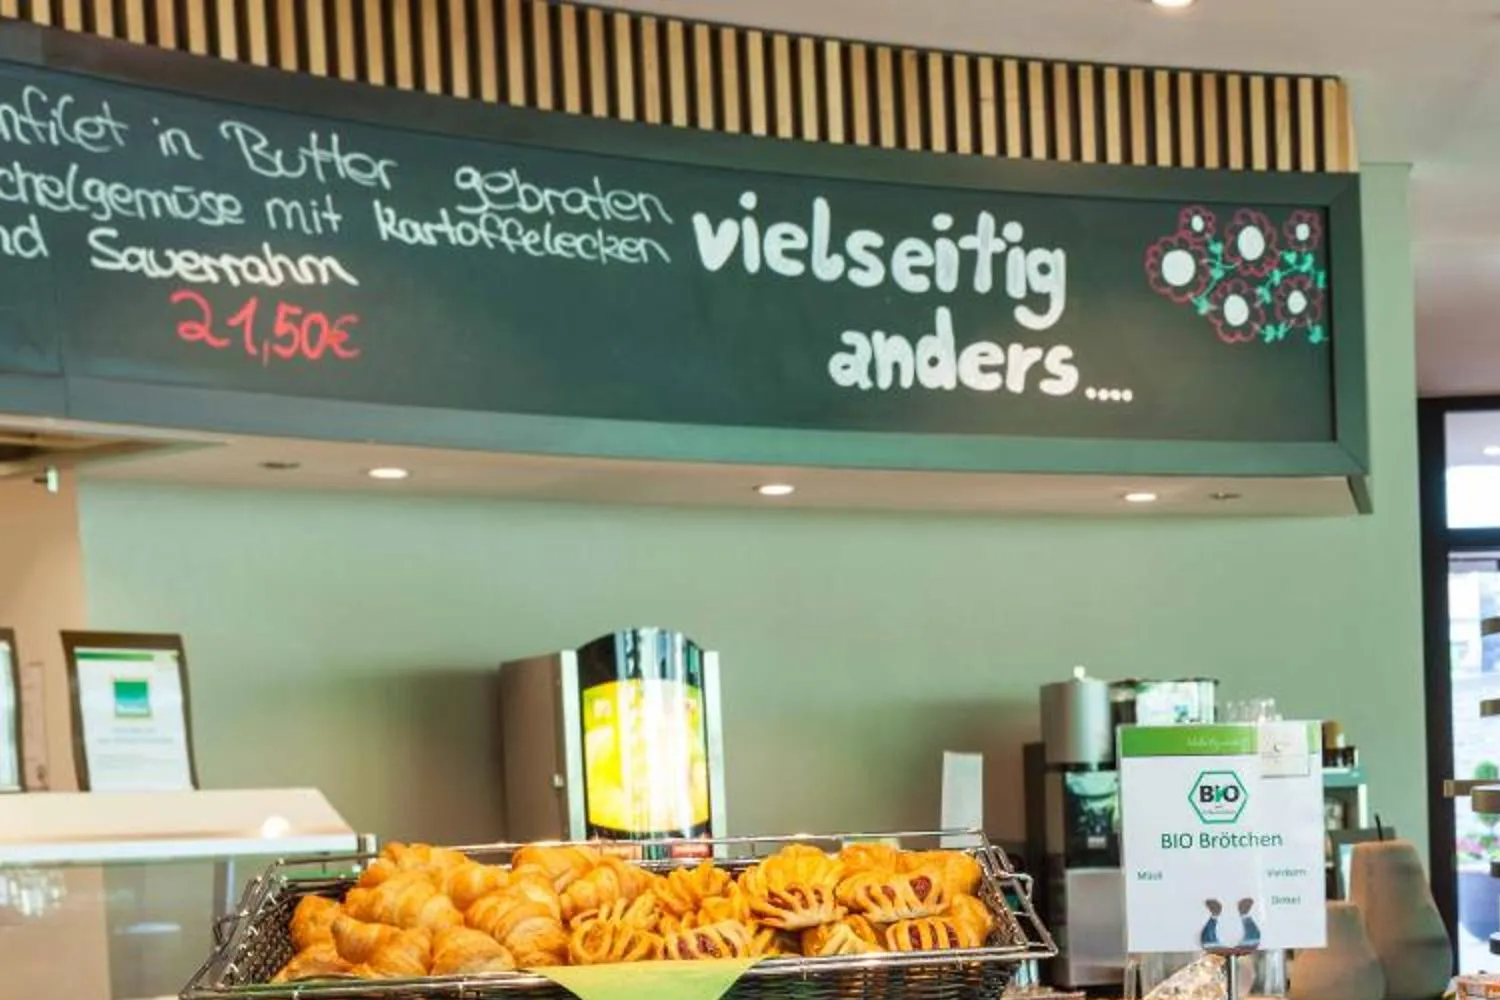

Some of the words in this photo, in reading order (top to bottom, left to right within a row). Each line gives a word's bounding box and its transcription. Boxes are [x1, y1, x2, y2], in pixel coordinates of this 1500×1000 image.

[152, 117, 204, 160] in
[220, 120, 398, 189] Butter
[454, 165, 672, 224] gebraten
[266, 194, 342, 235] mit
[88, 227, 358, 287] Sauerrahm
[692, 190, 1067, 329] vielseitig
[170, 290, 360, 365] 21,50€
[1161, 833, 1193, 849] BIO
[1199, 832, 1283, 849] Brötchen
